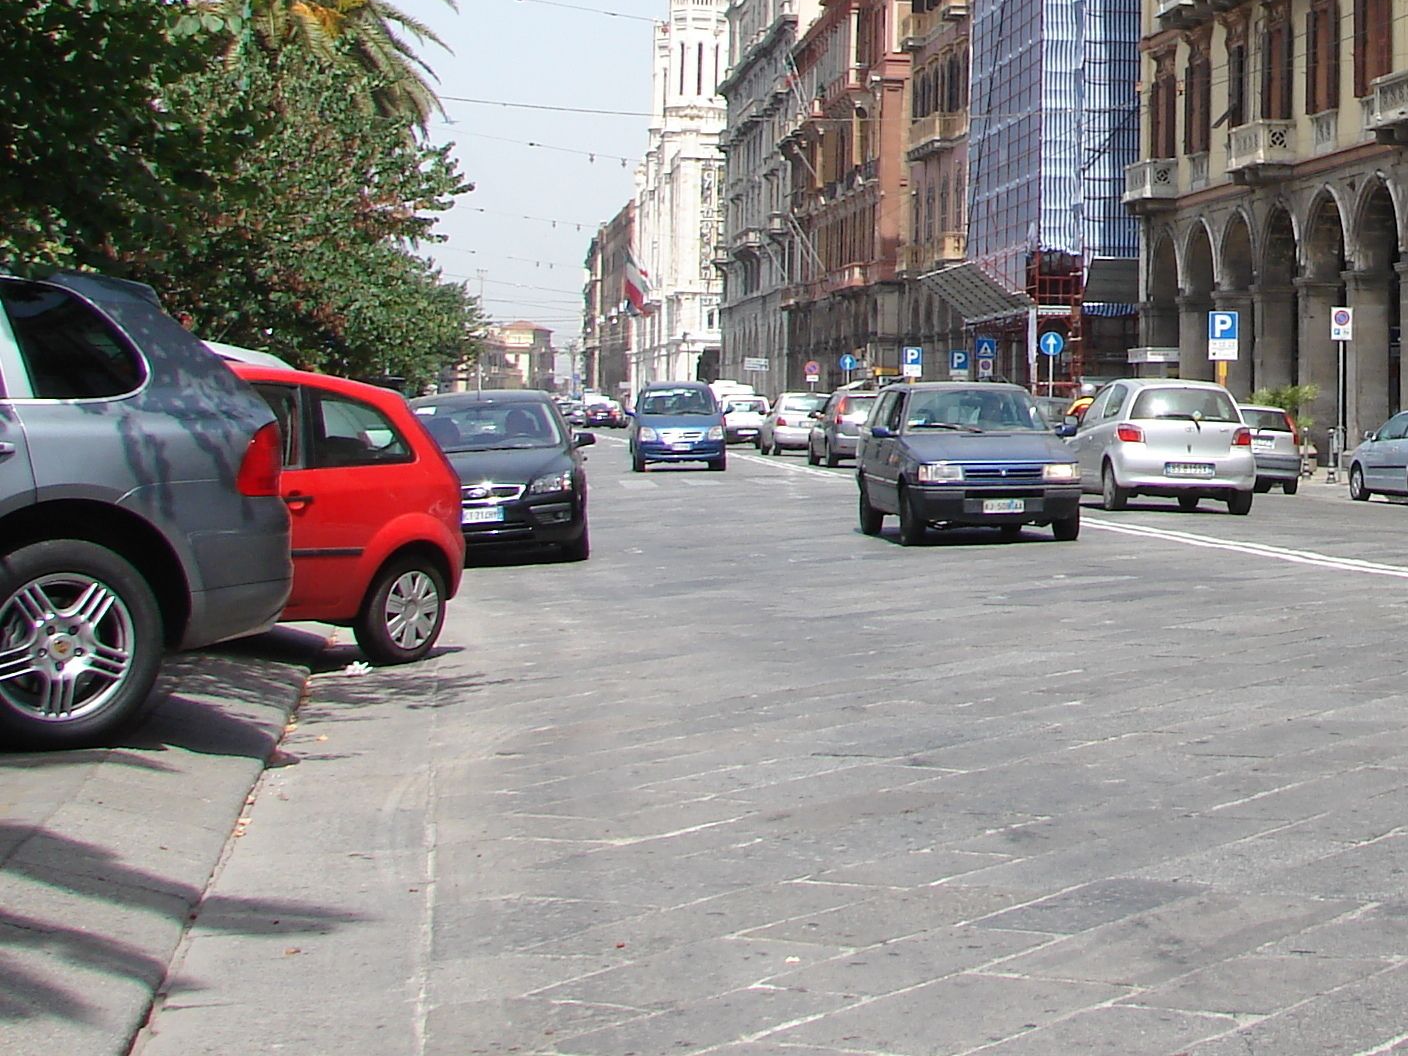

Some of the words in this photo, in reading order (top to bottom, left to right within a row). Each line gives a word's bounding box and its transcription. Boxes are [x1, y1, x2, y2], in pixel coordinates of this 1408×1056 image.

[1214, 314, 1232, 338] P
[906, 349, 919, 364] P
[953, 352, 966, 368] P
